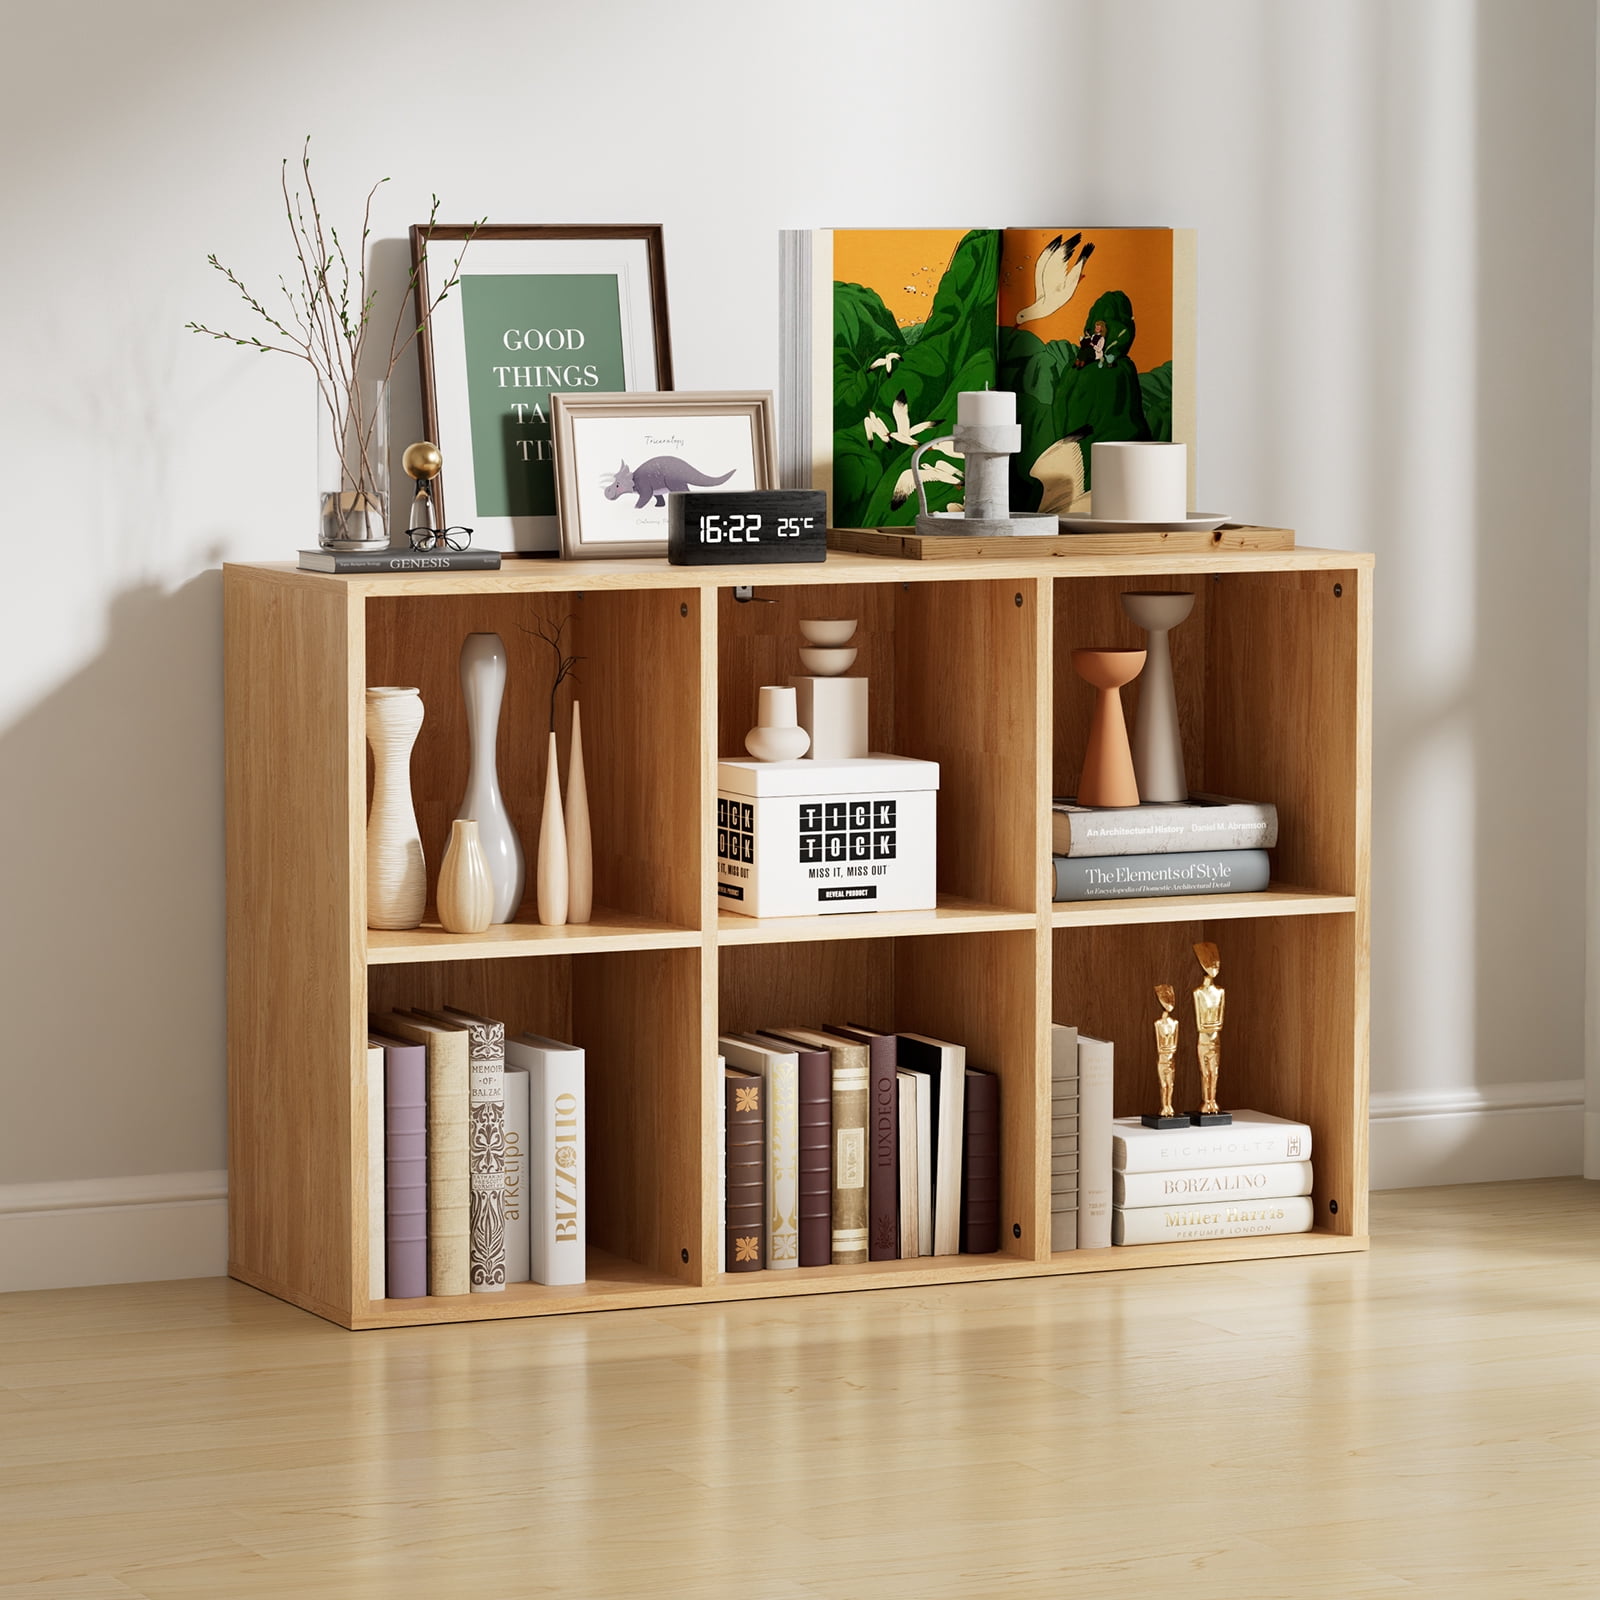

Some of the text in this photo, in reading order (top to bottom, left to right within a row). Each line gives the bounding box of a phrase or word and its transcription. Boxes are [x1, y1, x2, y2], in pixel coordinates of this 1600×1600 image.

[503, 328, 585, 351] GOOD
[492, 365, 599, 388] THINGS
[511, 402, 548, 424] TA
[516, 440, 553, 461] TI
[700, 514, 762, 543] 16:22
[389, 557, 451, 569] GENESIS
[720, 803, 751, 829] ICK
[806, 805, 890, 828] TICK
[1086, 821, 1267, 837] An Architectural History Daniel M. Abramson
[719, 833, 751, 859] OCK
[806, 835, 890, 858] TOCK
[808, 864, 888, 879] MISS IT, MISS OUT
[1085, 862, 1232, 884] The Elements of Style
[1094, 886, 1135, 895] Encyclopedia
[1142, 884, 1172, 892] Domestic
[1172, 881, 1212, 891] Architectural
[1212, 880, 1232, 889] Detail
[472, 1064, 503, 1074] MEMOIR
[472, 1087, 502, 1097] BALZAC
[877, 1077, 892, 1168] LUXDECO
[1160, 1140, 1276, 1158] EICHHOLTZ
[503, 1131, 524, 1221] arketipo
[1164, 1173, 1267, 1194] BORZALINO
[1164, 1206, 1285, 1227] Miller Harris
[1229, 1225, 1272, 1235] LONDON
